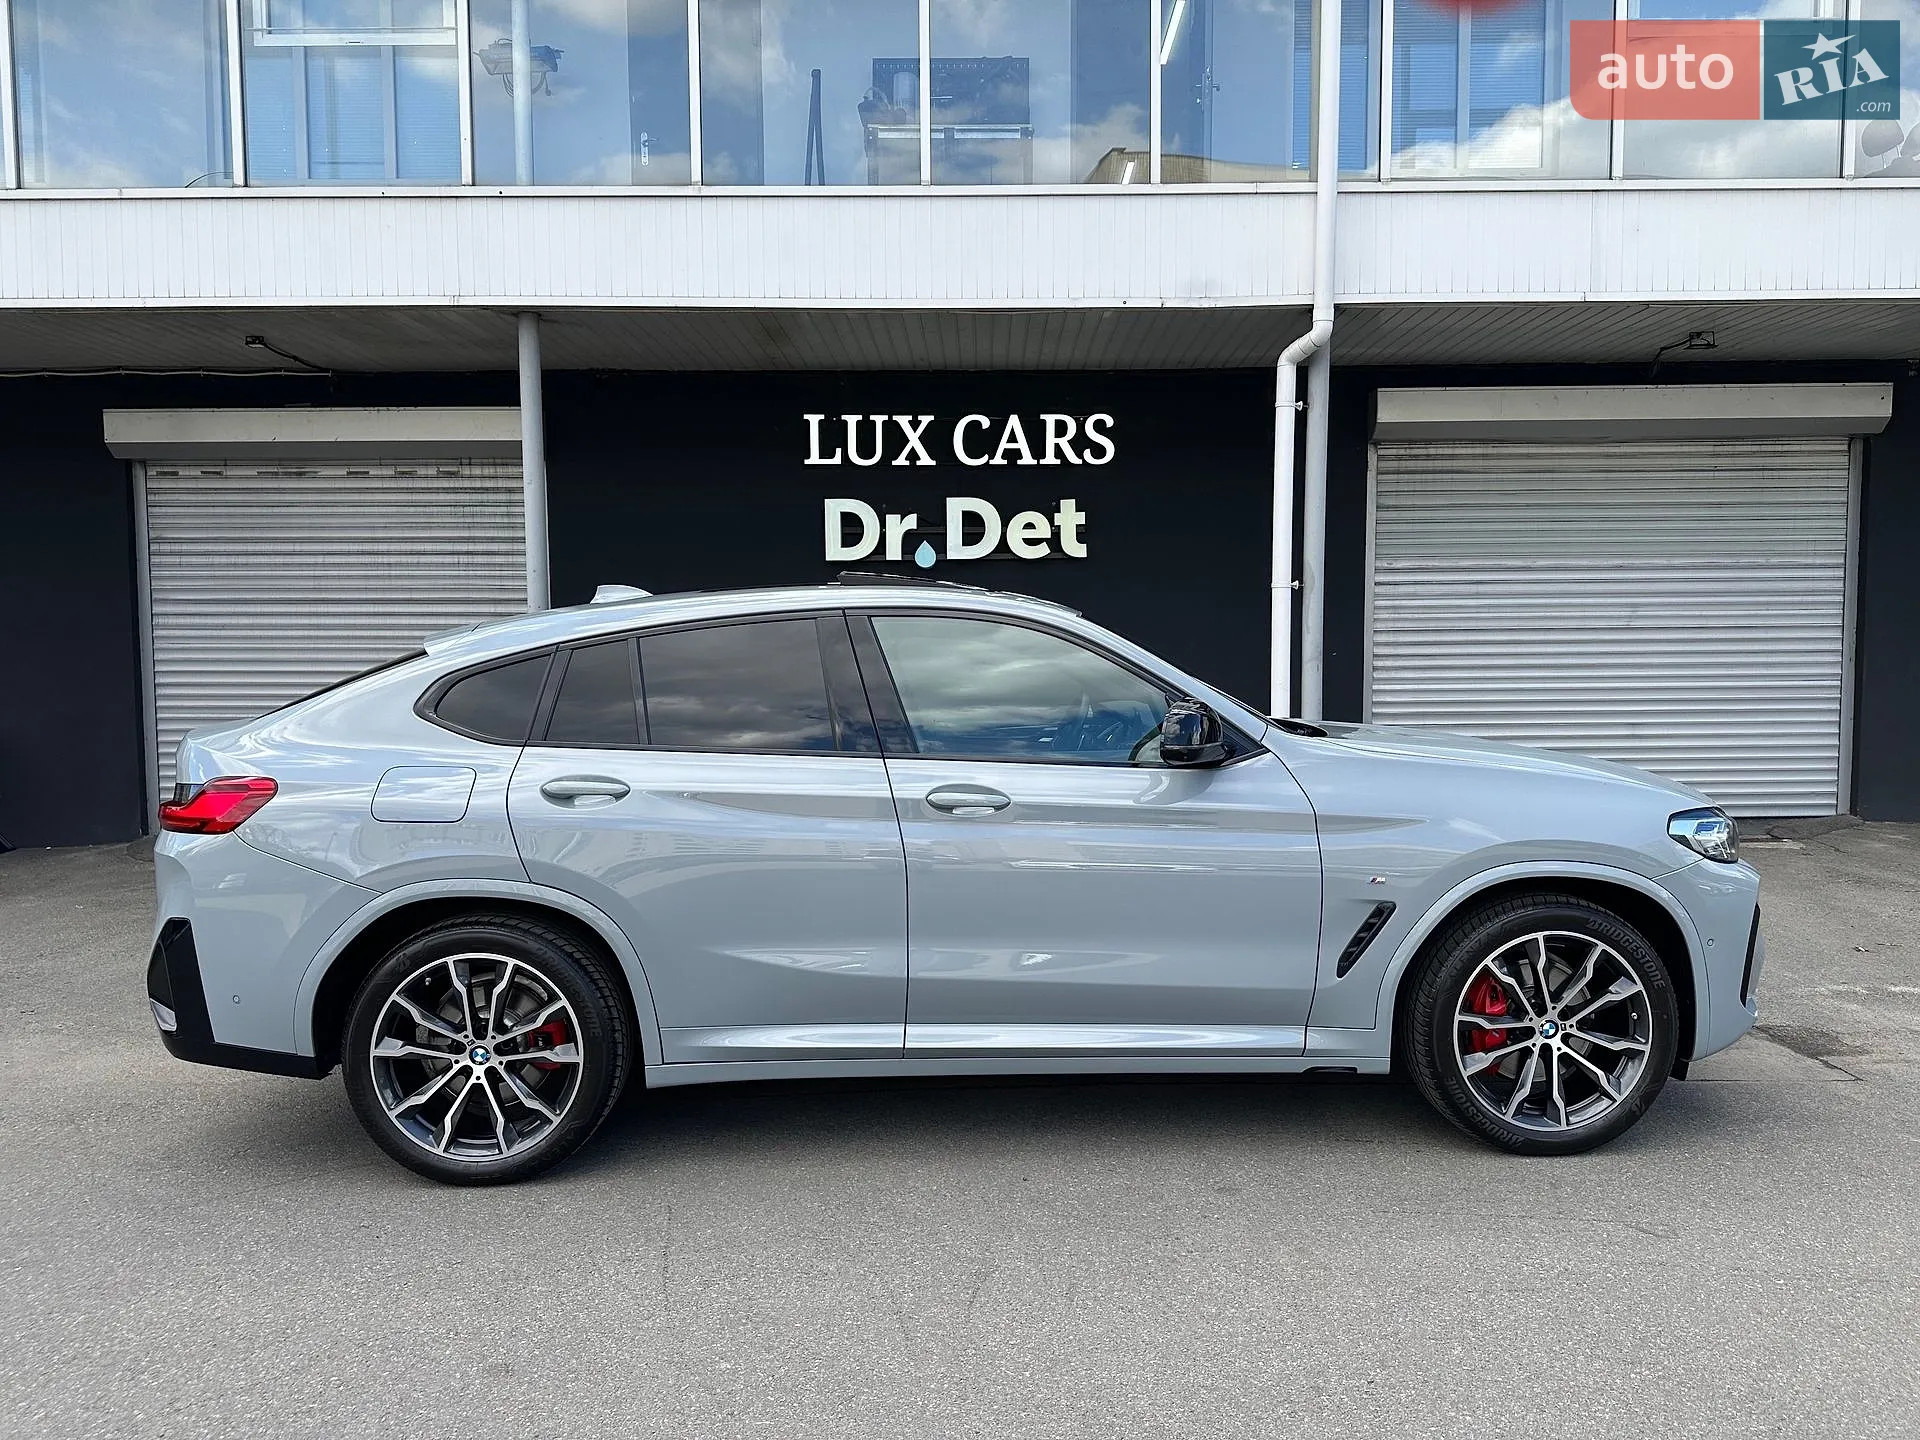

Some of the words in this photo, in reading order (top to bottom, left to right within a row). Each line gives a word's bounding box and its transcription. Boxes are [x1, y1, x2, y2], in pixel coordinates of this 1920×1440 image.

[803, 413, 936, 467] LUX
[953, 413, 1115, 467] CARS
[1585, 918, 1667, 989] BRIDGESTONE
